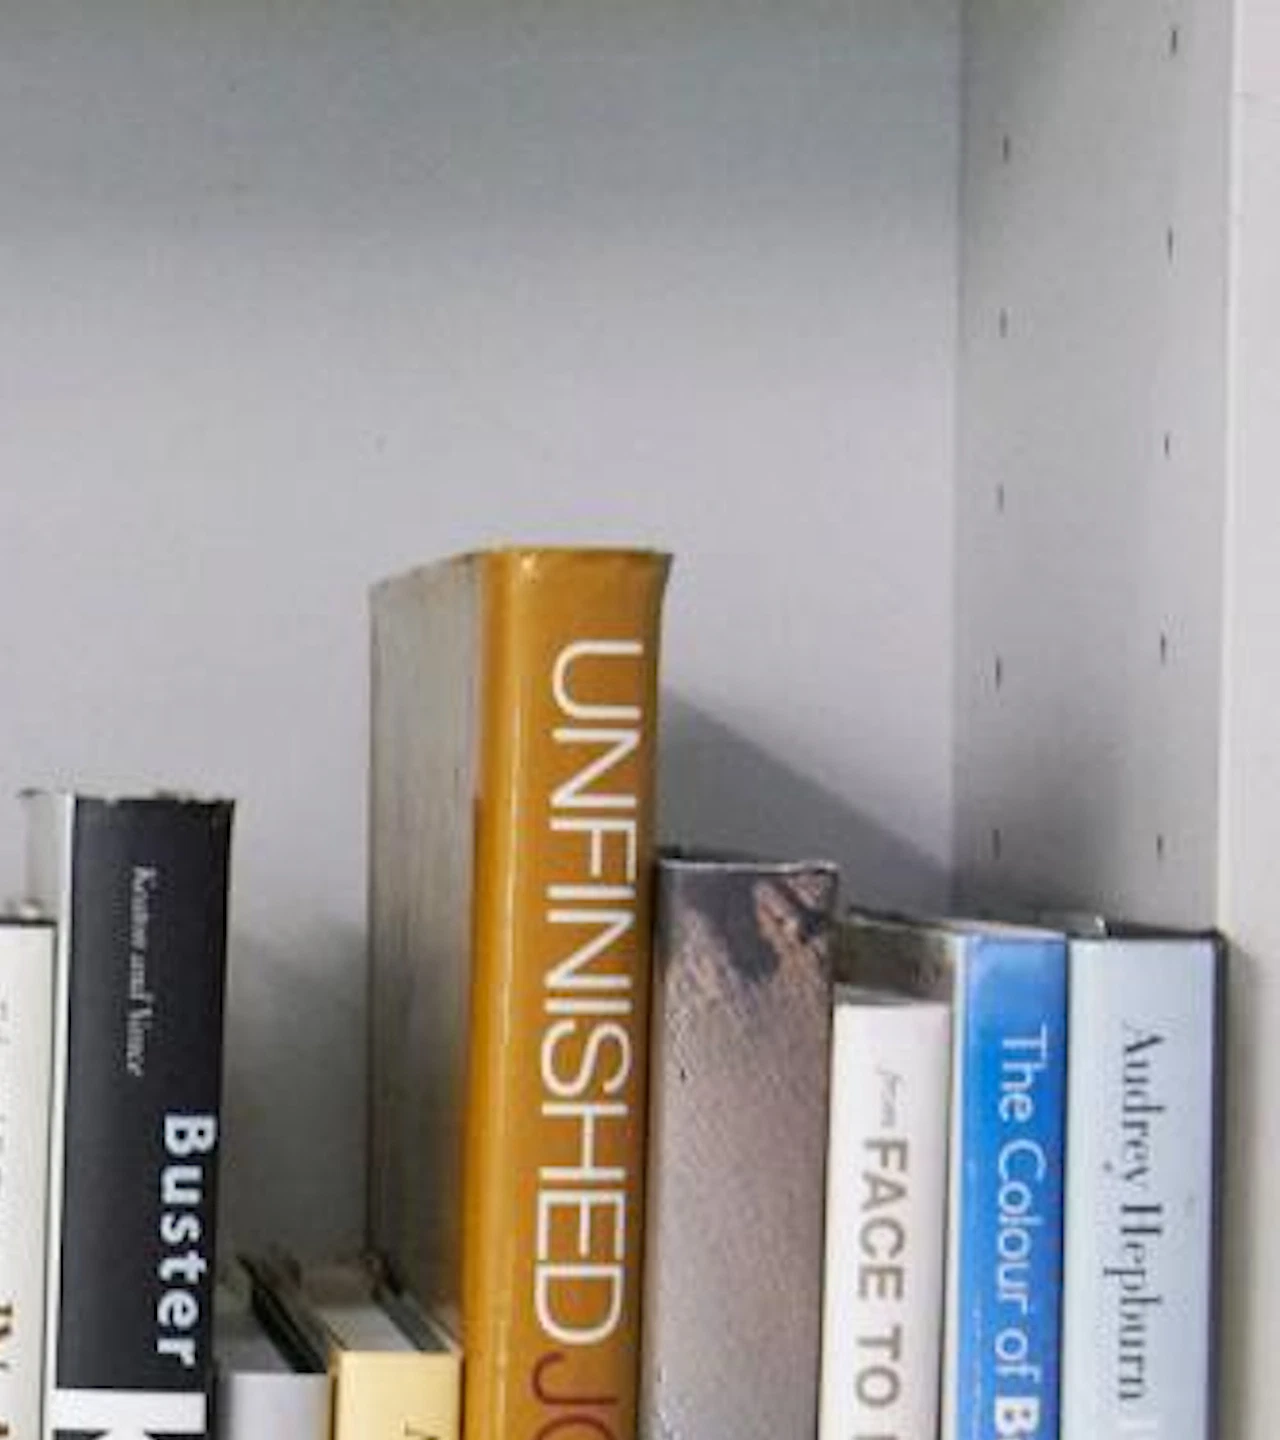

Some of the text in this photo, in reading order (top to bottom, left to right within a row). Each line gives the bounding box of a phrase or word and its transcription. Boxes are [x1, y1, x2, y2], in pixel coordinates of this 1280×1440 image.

[534, 639, 643, 1347] UNFINISHED
[999, 1028, 1047, 1123] The
[1102, 1022, 1164, 1194] Audrey
[157, 1114, 217, 1366] Buster
[856, 1137, 912, 1301] FACE
[996, 1142, 1046, 1314] Colour
[1105, 1203, 1162, 1400] Hepburn
[855, 1325, 902, 1409] TO
[994, 1334, 1041, 1388] of
